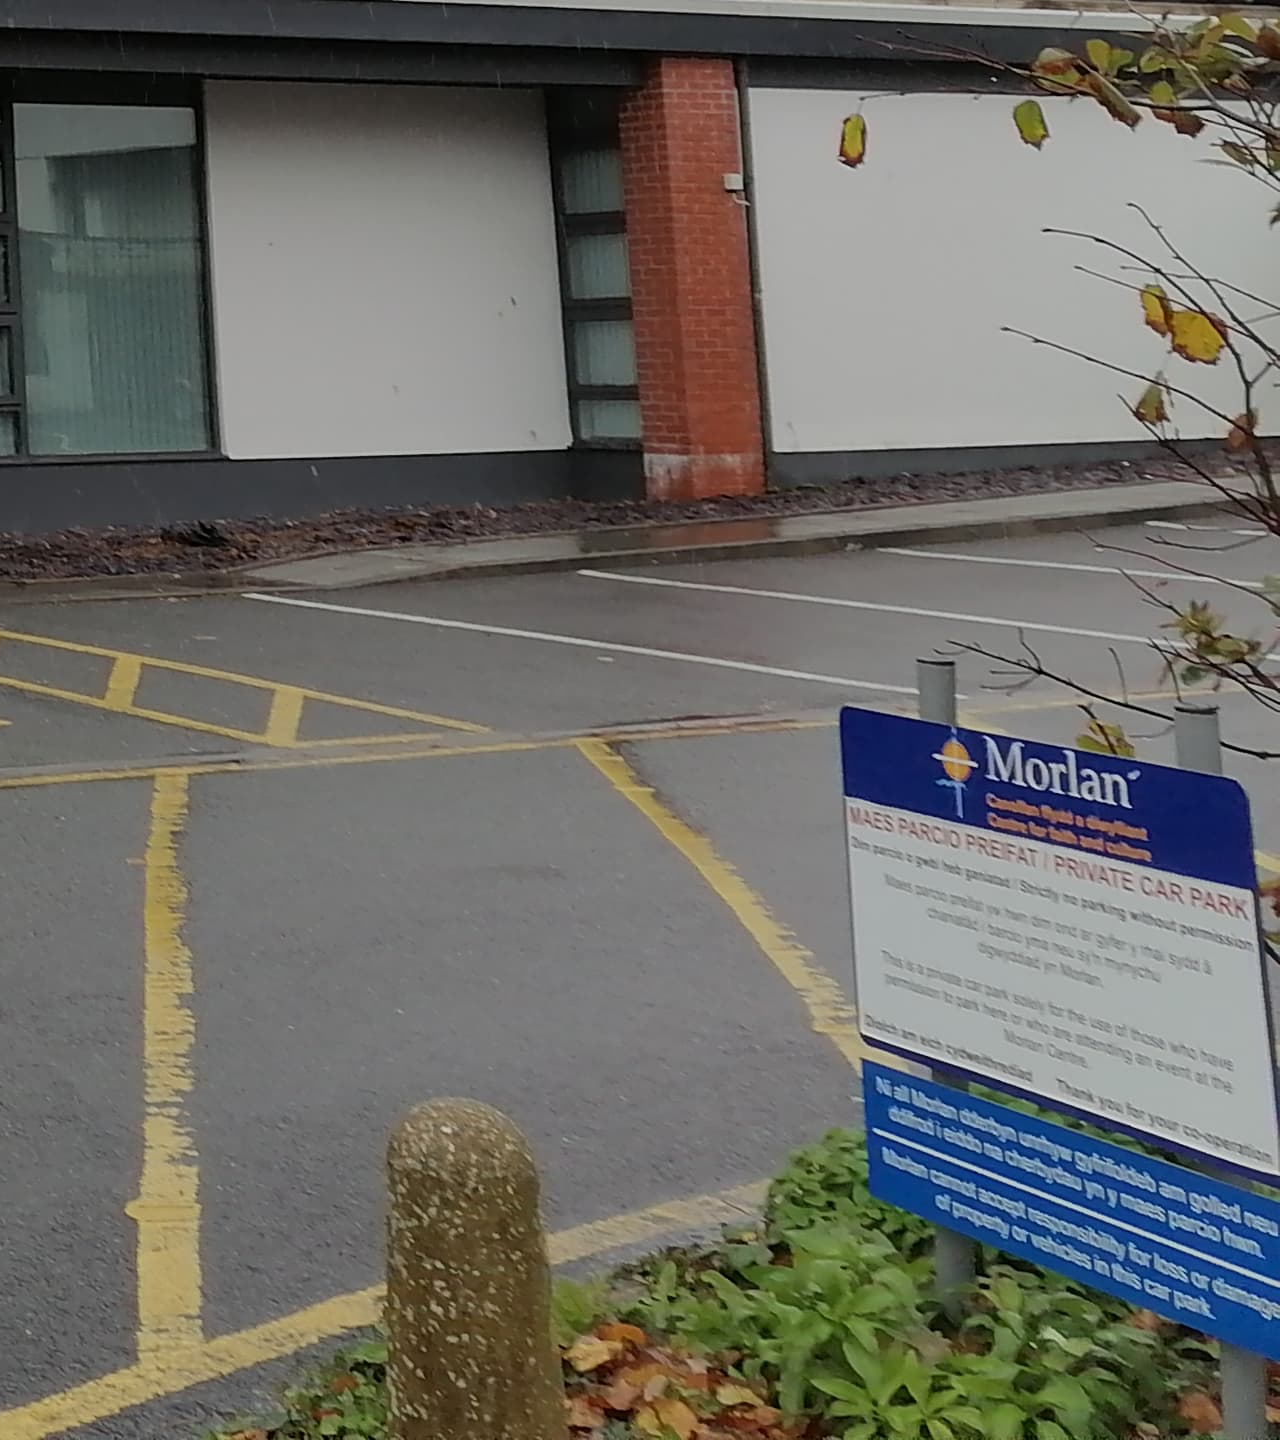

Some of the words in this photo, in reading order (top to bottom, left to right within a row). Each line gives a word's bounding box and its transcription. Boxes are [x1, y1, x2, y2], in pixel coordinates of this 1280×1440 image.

[983, 735, 1133, 809] Morlan
[849, 806, 894, 832] MAES
[898, 817, 961, 848] PARCIO
[965, 833, 1038, 867] PREIFAT
[1053, 854, 1134, 892] PRIVATE
[1140, 875, 1184, 904] CAR
[1189, 887, 1249, 921] PARK
[1080, 898, 1126, 922] parking
[1129, 911, 1177, 932] without
[1200, 1048, 1234, 1072] have
[1056, 1078, 1094, 1104] Thank
[1097, 1096, 1124, 1114] you
[1125, 1102, 1145, 1120] for
[1149, 1113, 1180, 1132] your
[928, 1169, 977, 1200] cannot
[977, 1188, 1027, 1219] accept
[1027, 1207, 1126, 1261] responsibility
[1127, 1242, 1152, 1268] for
[1153, 1252, 1188, 1283] loss
[1190, 1271, 1210, 1291] or
[935, 1194, 951, 1213] of
[951, 1201, 1010, 1239] property
[1011, 1225, 1027, 1243] or
[1030, 1232, 1092, 1270] vehicles
[1093, 1254, 1110, 1277] in
[1111, 1262, 1141, 1290] this
[1143, 1279, 1171, 1302] car
